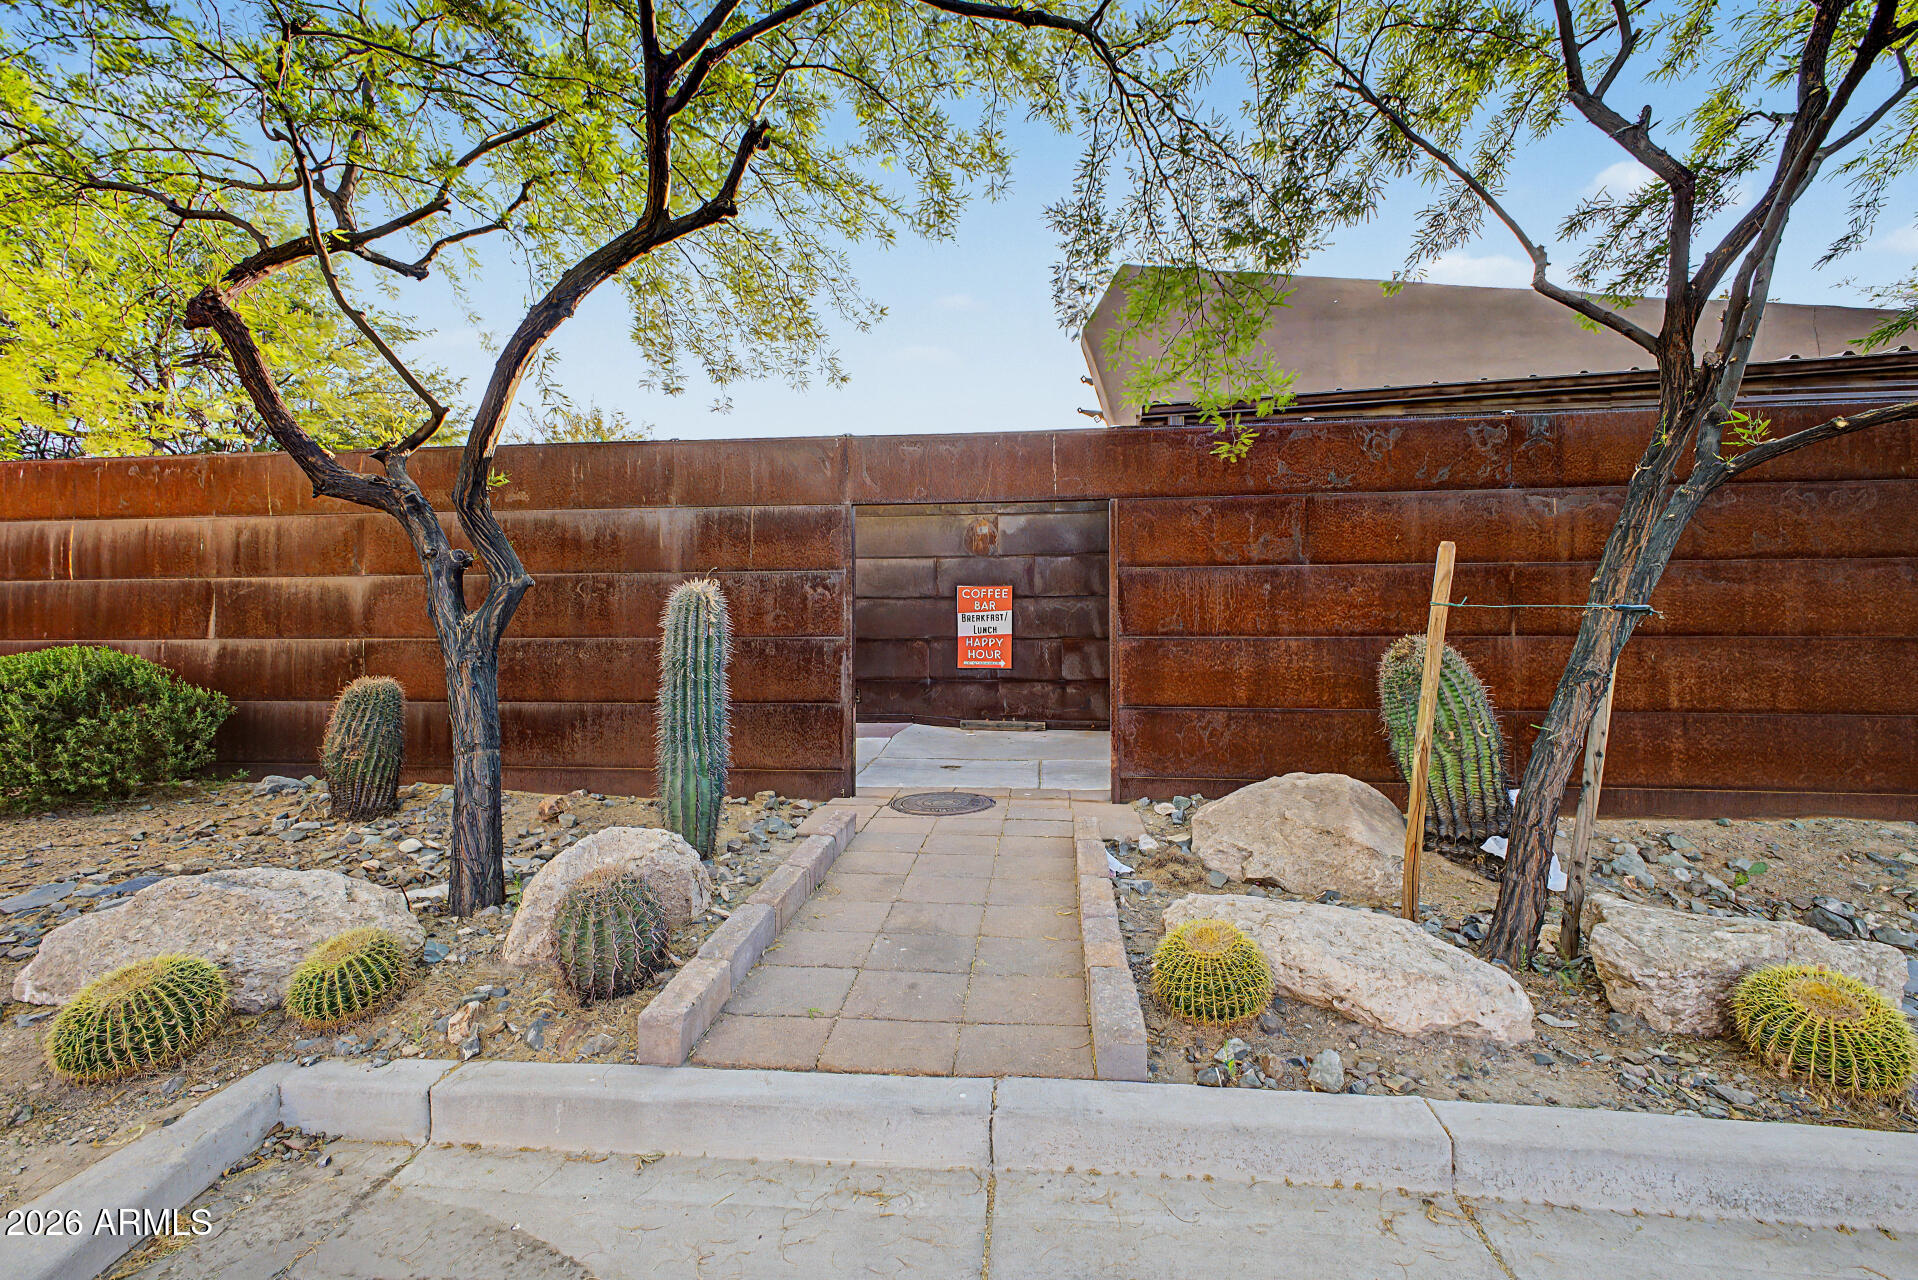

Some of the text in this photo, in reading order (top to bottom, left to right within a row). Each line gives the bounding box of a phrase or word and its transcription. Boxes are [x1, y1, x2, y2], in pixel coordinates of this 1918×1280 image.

[962, 588, 1008, 599] COFFEE
[974, 600, 996, 611] BAR
[973, 625, 997, 634] LUNCH
[966, 637, 1004, 647] HAPPY
[968, 649, 1001, 659] HOUR
